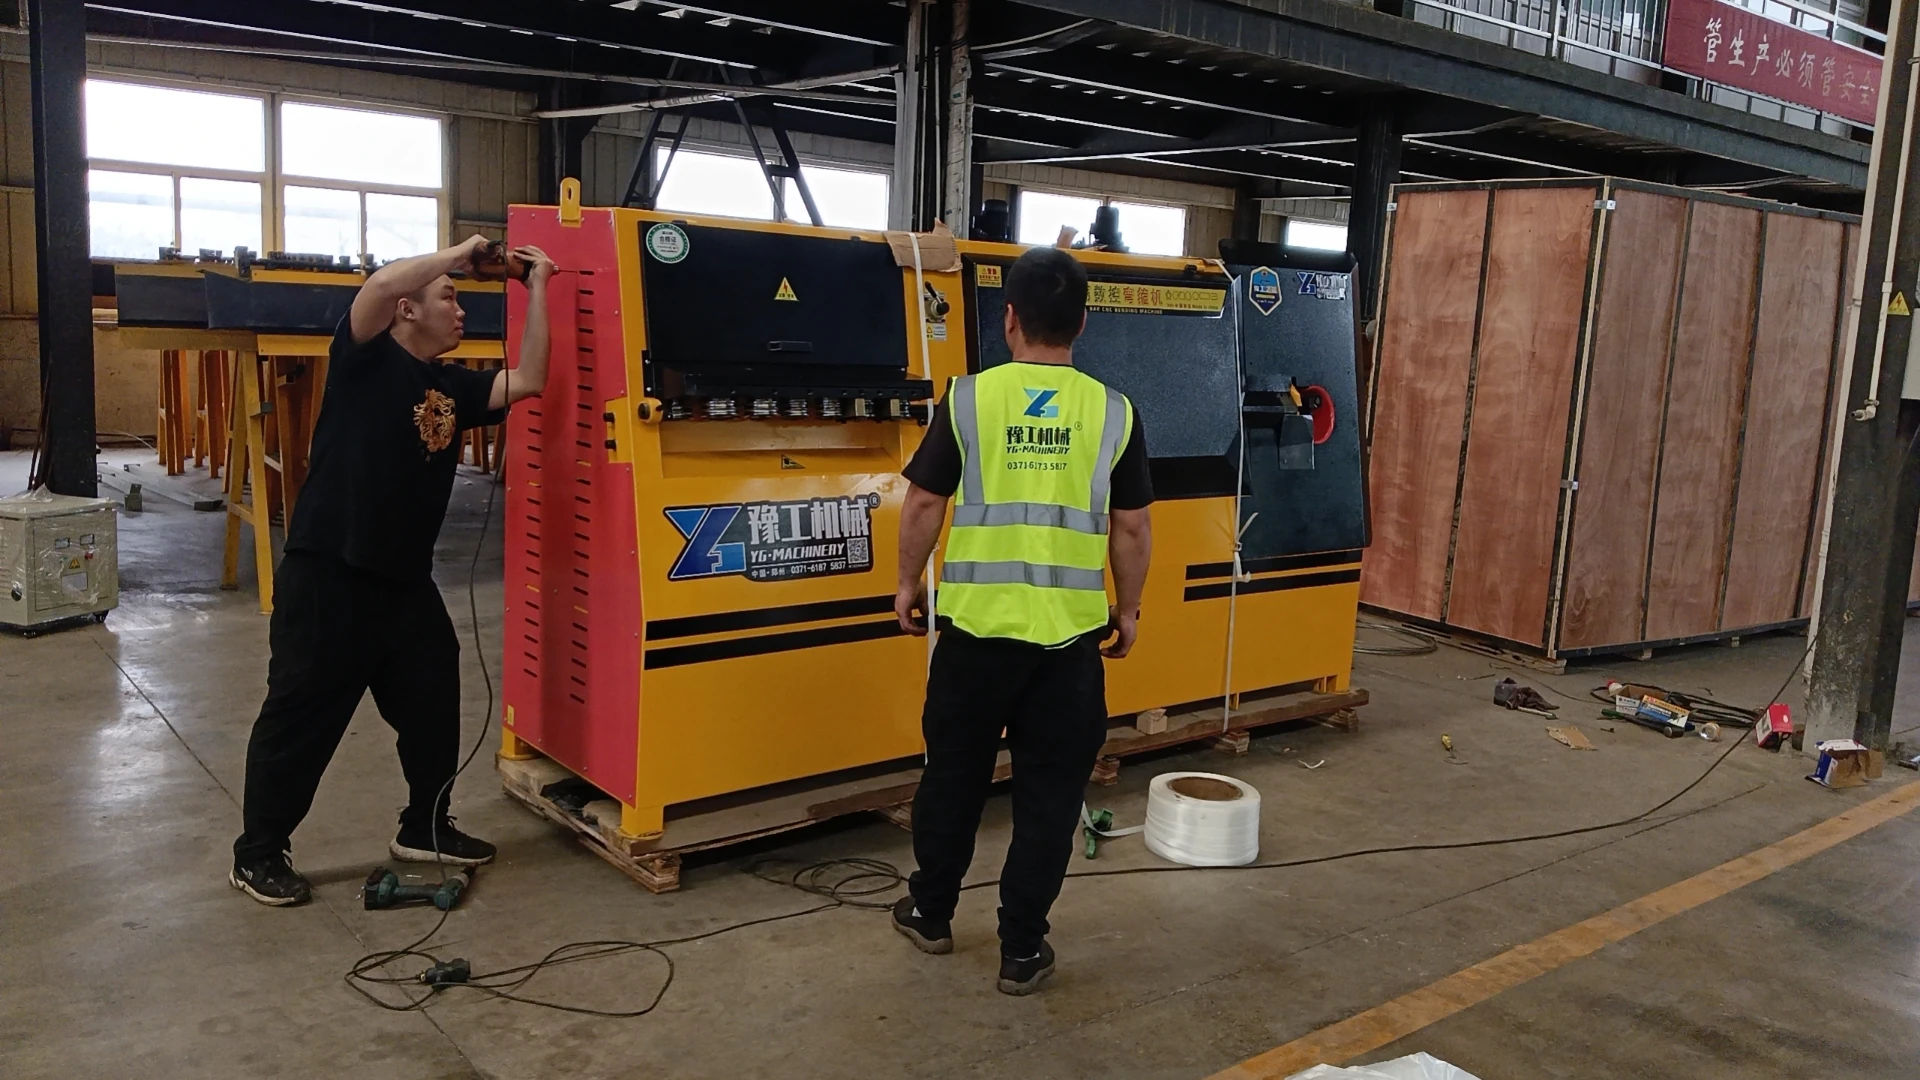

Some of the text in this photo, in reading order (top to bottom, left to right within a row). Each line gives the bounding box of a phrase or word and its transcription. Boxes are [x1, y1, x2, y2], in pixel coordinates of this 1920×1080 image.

[1006, 425, 1072, 446] 豫工机械
[747, 498, 870, 545] 豫工机械
[830, 561, 846, 571] 5837
